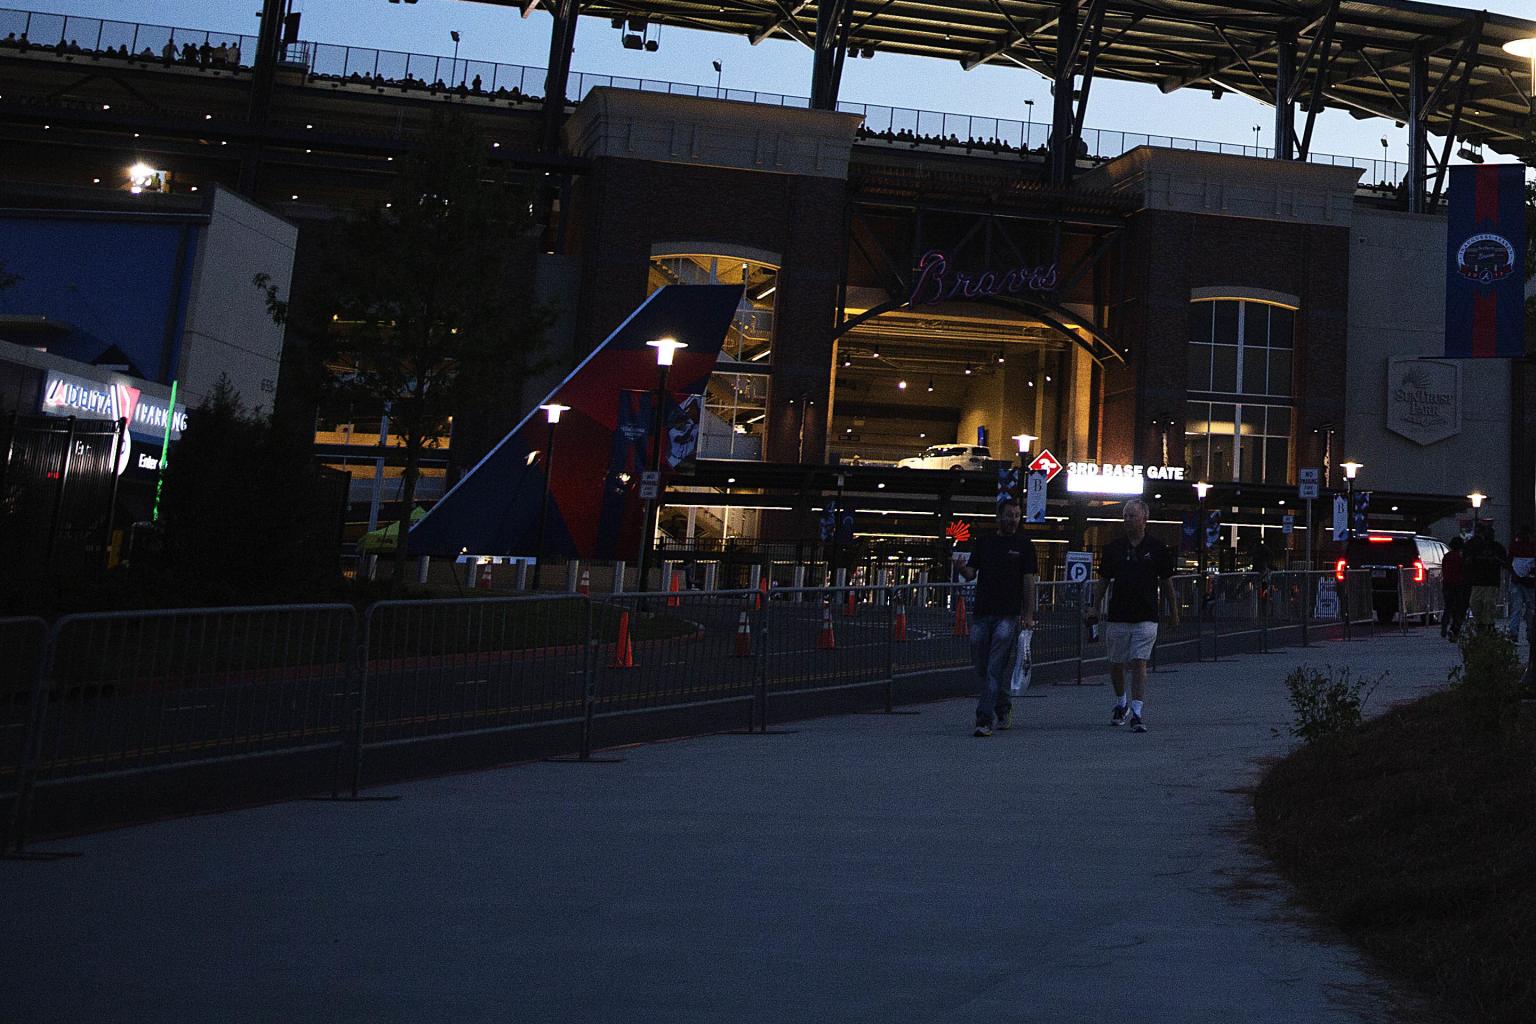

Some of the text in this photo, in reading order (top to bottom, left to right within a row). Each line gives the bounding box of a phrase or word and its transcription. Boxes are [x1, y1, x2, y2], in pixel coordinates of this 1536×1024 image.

[910, 249, 1056, 310] Braves
[135, 403, 189, 431] PARKNG
[1067, 462, 1184, 480] 3RD BASE GATE
